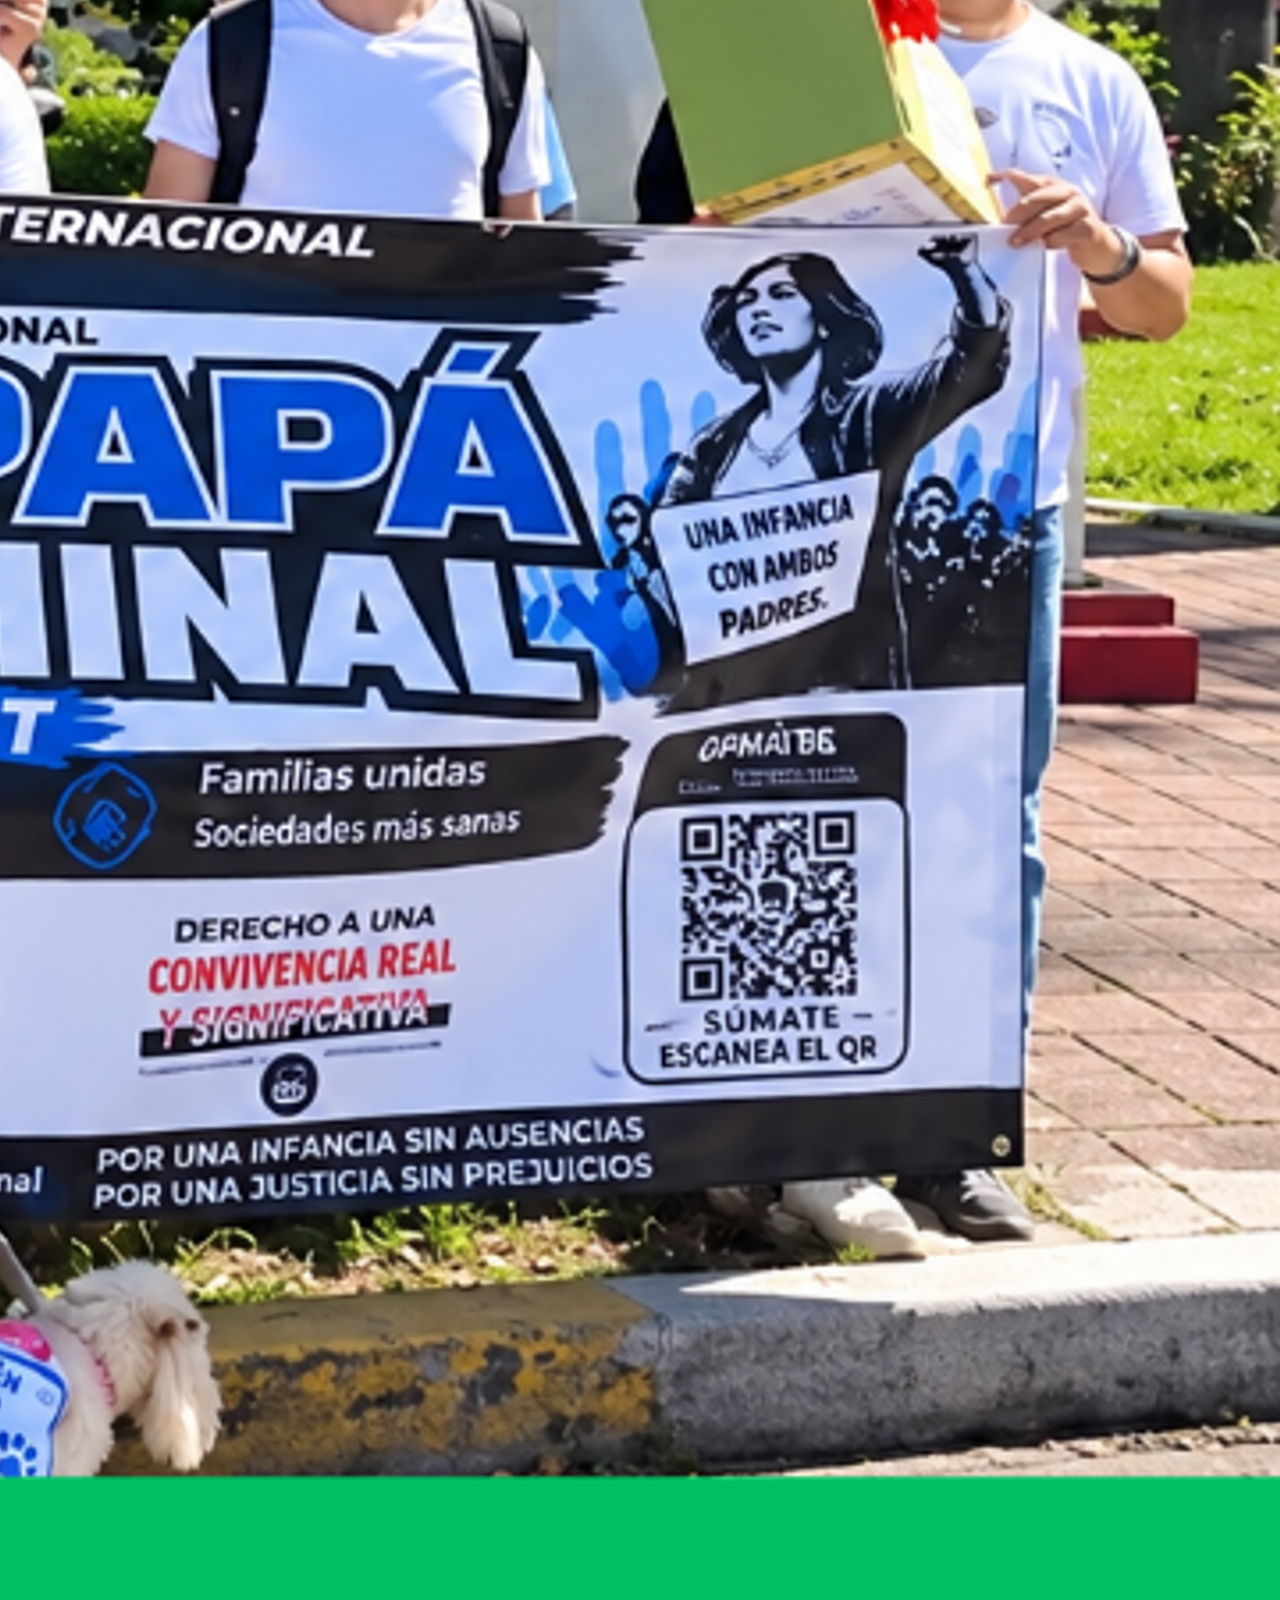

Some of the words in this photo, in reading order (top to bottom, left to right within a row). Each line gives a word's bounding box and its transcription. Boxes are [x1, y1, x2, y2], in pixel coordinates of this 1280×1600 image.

[684, 514, 738, 551] UNA
[742, 492, 855, 539] INFANCIA
[707, 558, 758, 593] CON
[764, 539, 839, 579] AMBOS
[718, 587, 829, 639] PADRES.
[200, 757, 354, 794] Familias
[365, 756, 487, 791] unidas
[193, 813, 365, 848] Sociedades
[373, 809, 434, 841] más
[440, 809, 522, 837] sanas
[174, 912, 331, 944] DERECHO
[338, 909, 362, 935] A
[370, 904, 436, 933] UNA
[148, 944, 368, 995] CONVIVENCIA
[377, 938, 457, 978] REAL
[160, 1008, 182, 1050] Y
[190, 988, 429, 1048] SIGNIFICATIVA
[704, 1003, 840, 1036] SÚMATE
[660, 1038, 790, 1069] ESCANEA
[797, 1037, 830, 1063] EL
[837, 1035, 877, 1065] QR
[97, 1145, 164, 1174] POR
[173, 1140, 242, 1170] UNA
[250, 1128, 397, 1165] INFANCIA
[404, 1126, 457, 1154] SIN
[464, 1116, 645, 1151] AUSENCIAS
[93, 1182, 164, 1210] POR
[170, 1176, 243, 1206] UNA
[248, 1166, 394, 1200] JUSTICIA
[400, 1164, 453, 1192] SIN
[464, 1153, 654, 1188] PREJUICIOS
